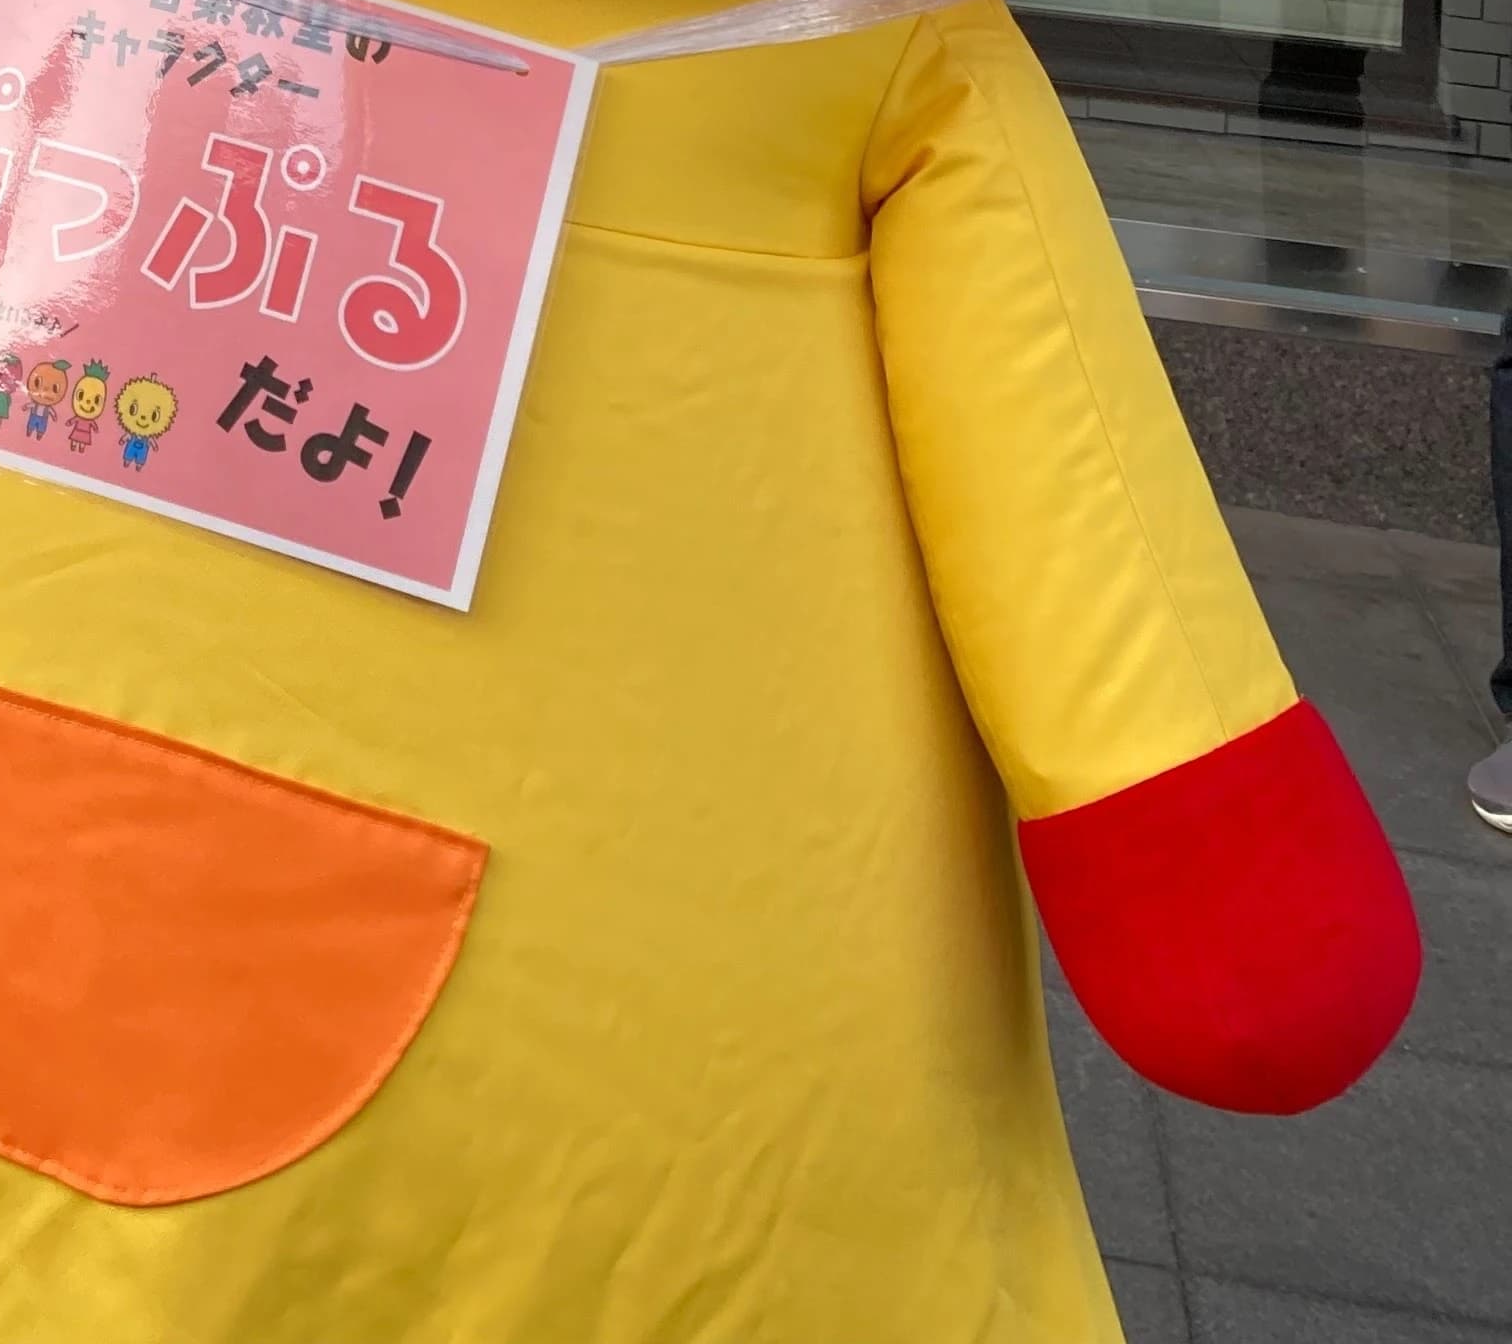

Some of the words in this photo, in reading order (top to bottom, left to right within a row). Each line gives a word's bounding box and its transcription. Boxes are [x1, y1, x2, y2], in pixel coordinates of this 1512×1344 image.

[71, 9, 320, 98] キャラクター
[214, 353, 433, 520] だよ!
